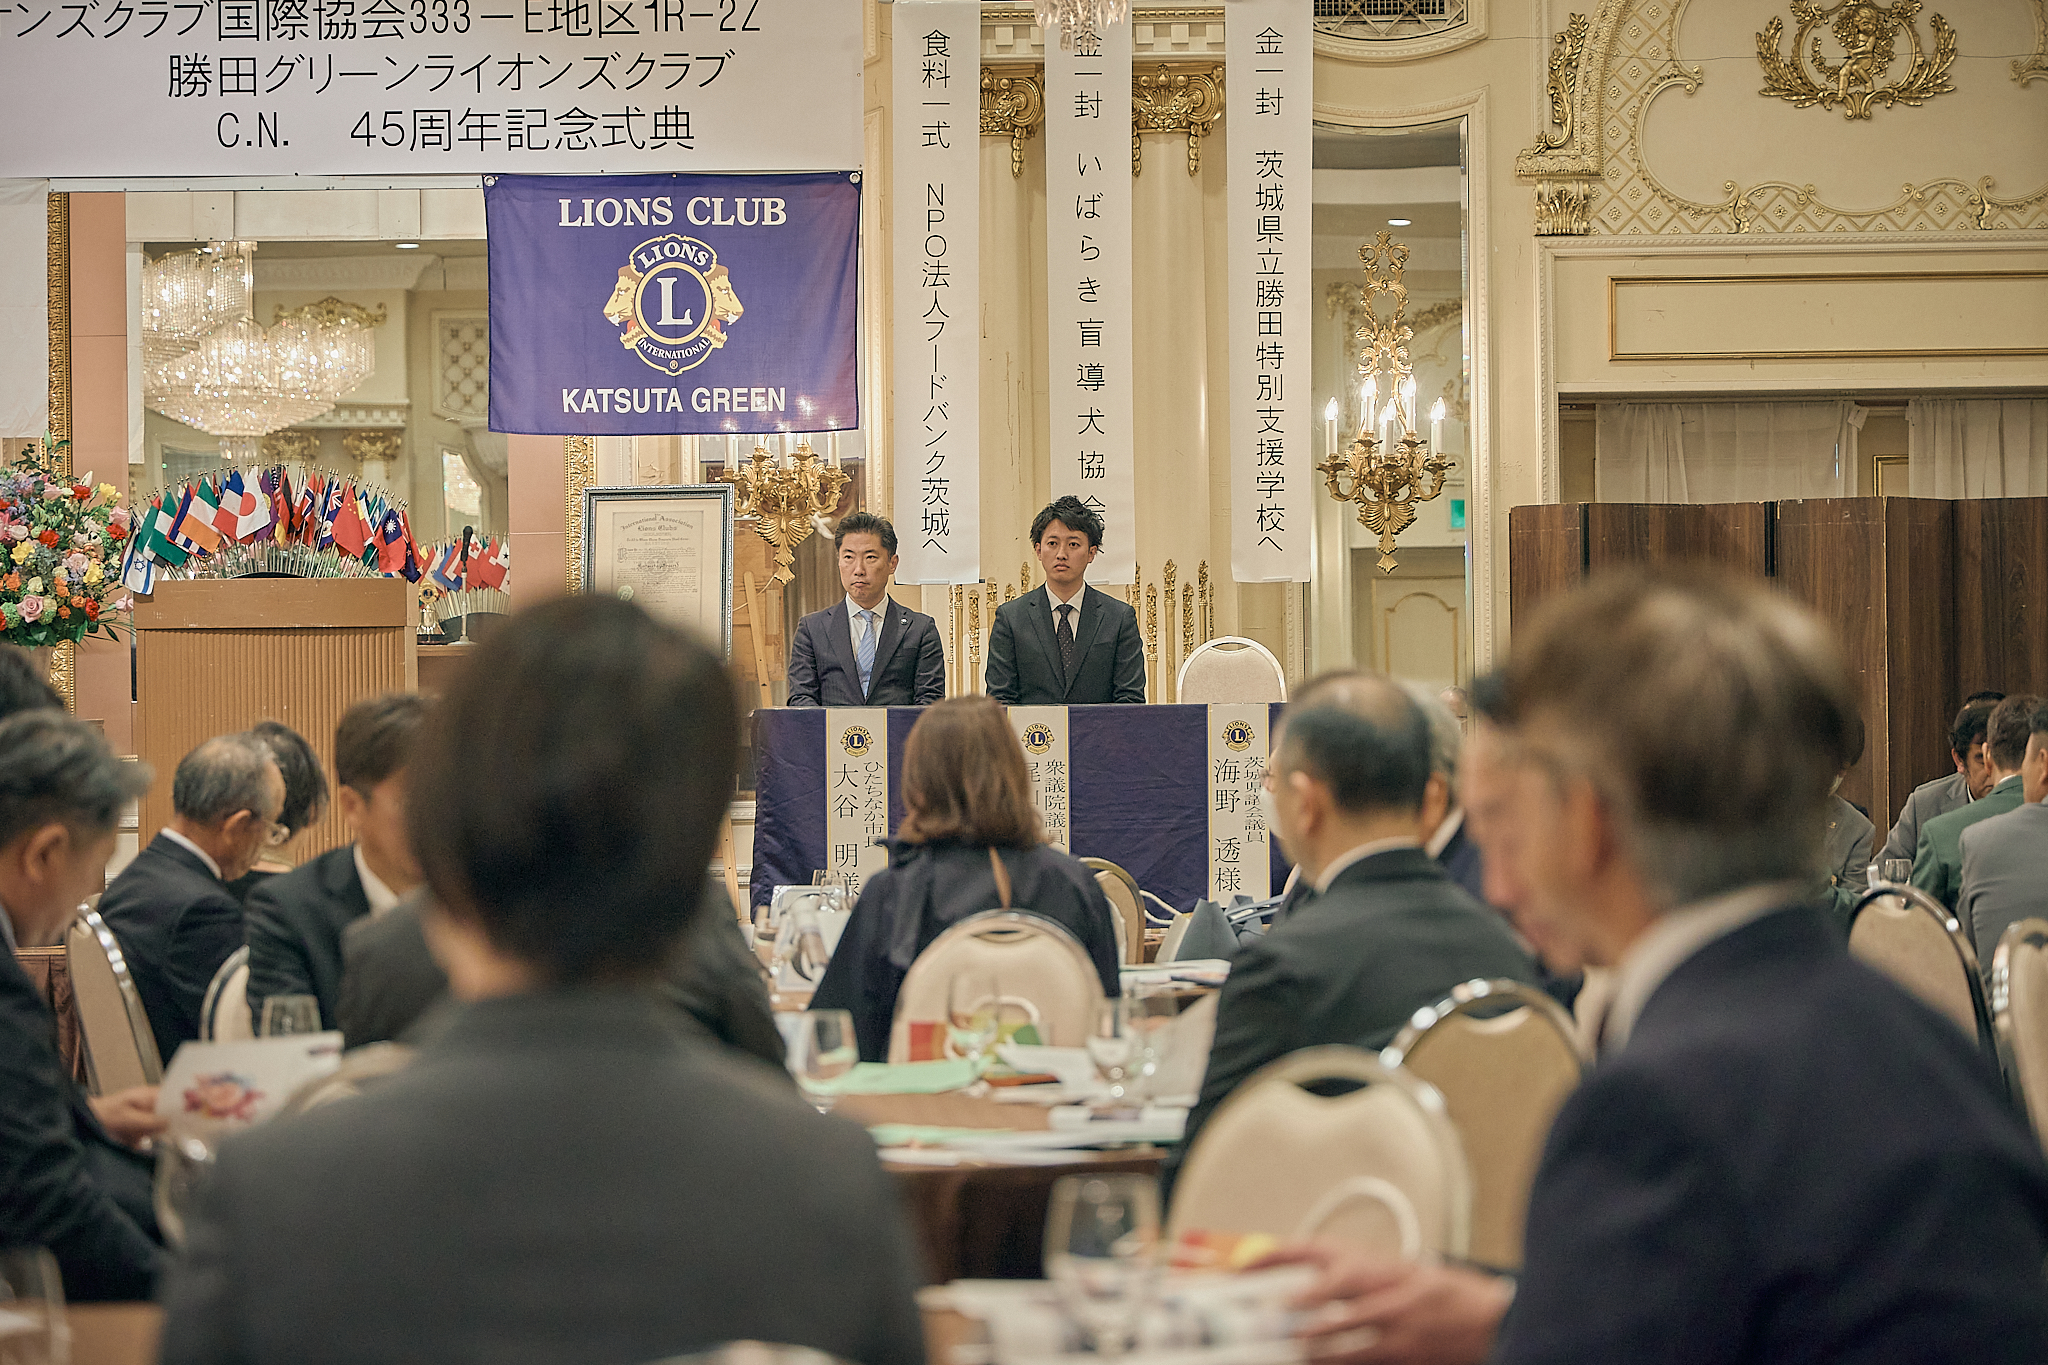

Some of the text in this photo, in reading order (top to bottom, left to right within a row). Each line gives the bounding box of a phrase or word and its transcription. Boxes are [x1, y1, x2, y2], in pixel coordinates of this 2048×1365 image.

[168, 49, 736, 97] 勝田グリーンライオンズクラブ
[217, 105, 695, 151] C.N. 45周年記念式典
[558, 196, 787, 227] LIONS CLUB
[637, 241, 710, 270] LIONS
[656, 276, 694, 326] L
[921, 29, 951, 555] 食料一式 NPO法人フードバンク茨城へ
[1255, 26, 1285, 552] 金一封 茨城県立勝田特別支援学校へ
[637, 337, 711, 360] INTERNATIONAL
[1075, 152, 1106, 554] いばらき盲導犬協会
[562, 386, 786, 414] KATSUTA GREEN
[847, 726, 867, 734] LIONS
[852, 735, 862, 747] L
[1028, 724, 1048, 732] LIONS
[1033, 732, 1044, 745] L
[1228, 721, 1248, 729] LIONS
[1234, 729, 1244, 742] L
[833, 763, 859, 819] 大谷
[863, 761, 885, 849] ひたちなか市長
[1044, 759, 1066, 846] 衆議院議員
[1214, 758, 1241, 813] 海野
[1214, 837, 1241, 892] 透様
